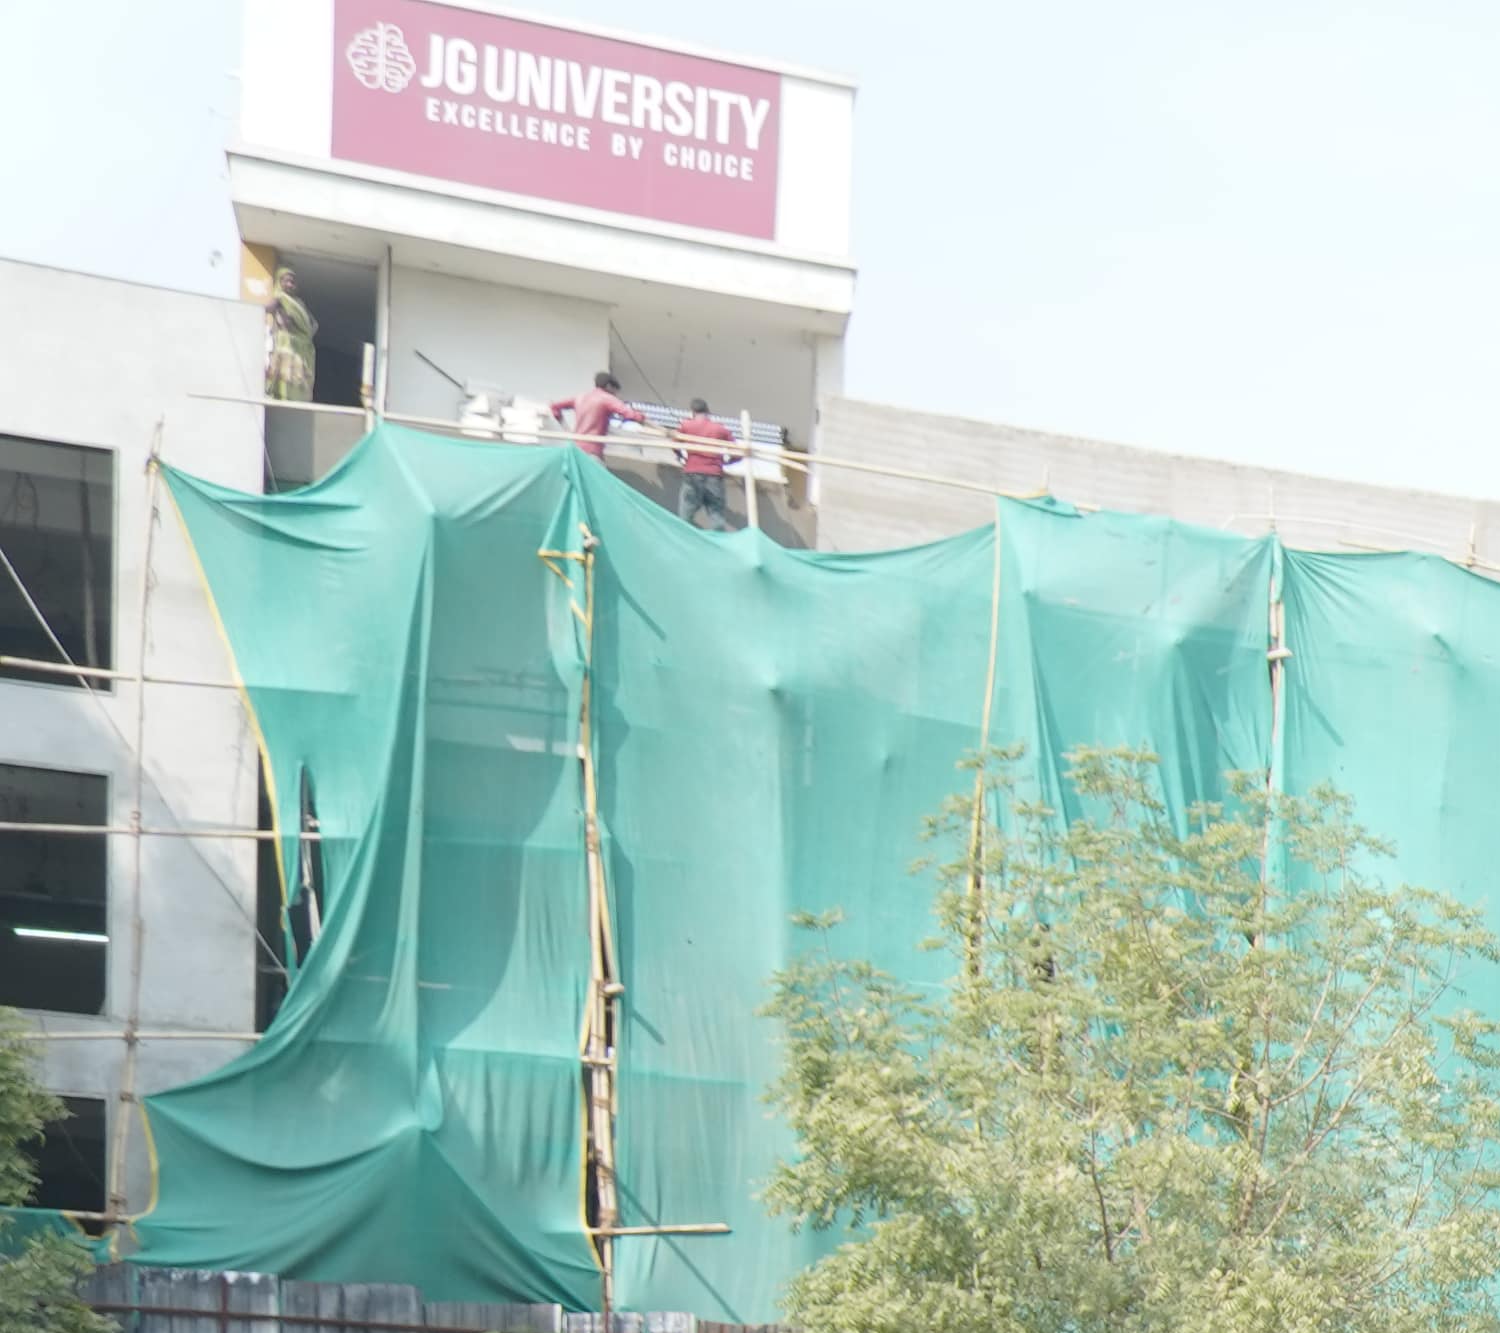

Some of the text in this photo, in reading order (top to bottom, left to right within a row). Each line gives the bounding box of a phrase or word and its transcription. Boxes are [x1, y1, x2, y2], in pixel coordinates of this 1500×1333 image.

[421, 33, 771, 150] JG UNIVERSITY
[425, 97, 755, 182] EXCELLENCE BY CHOICE
